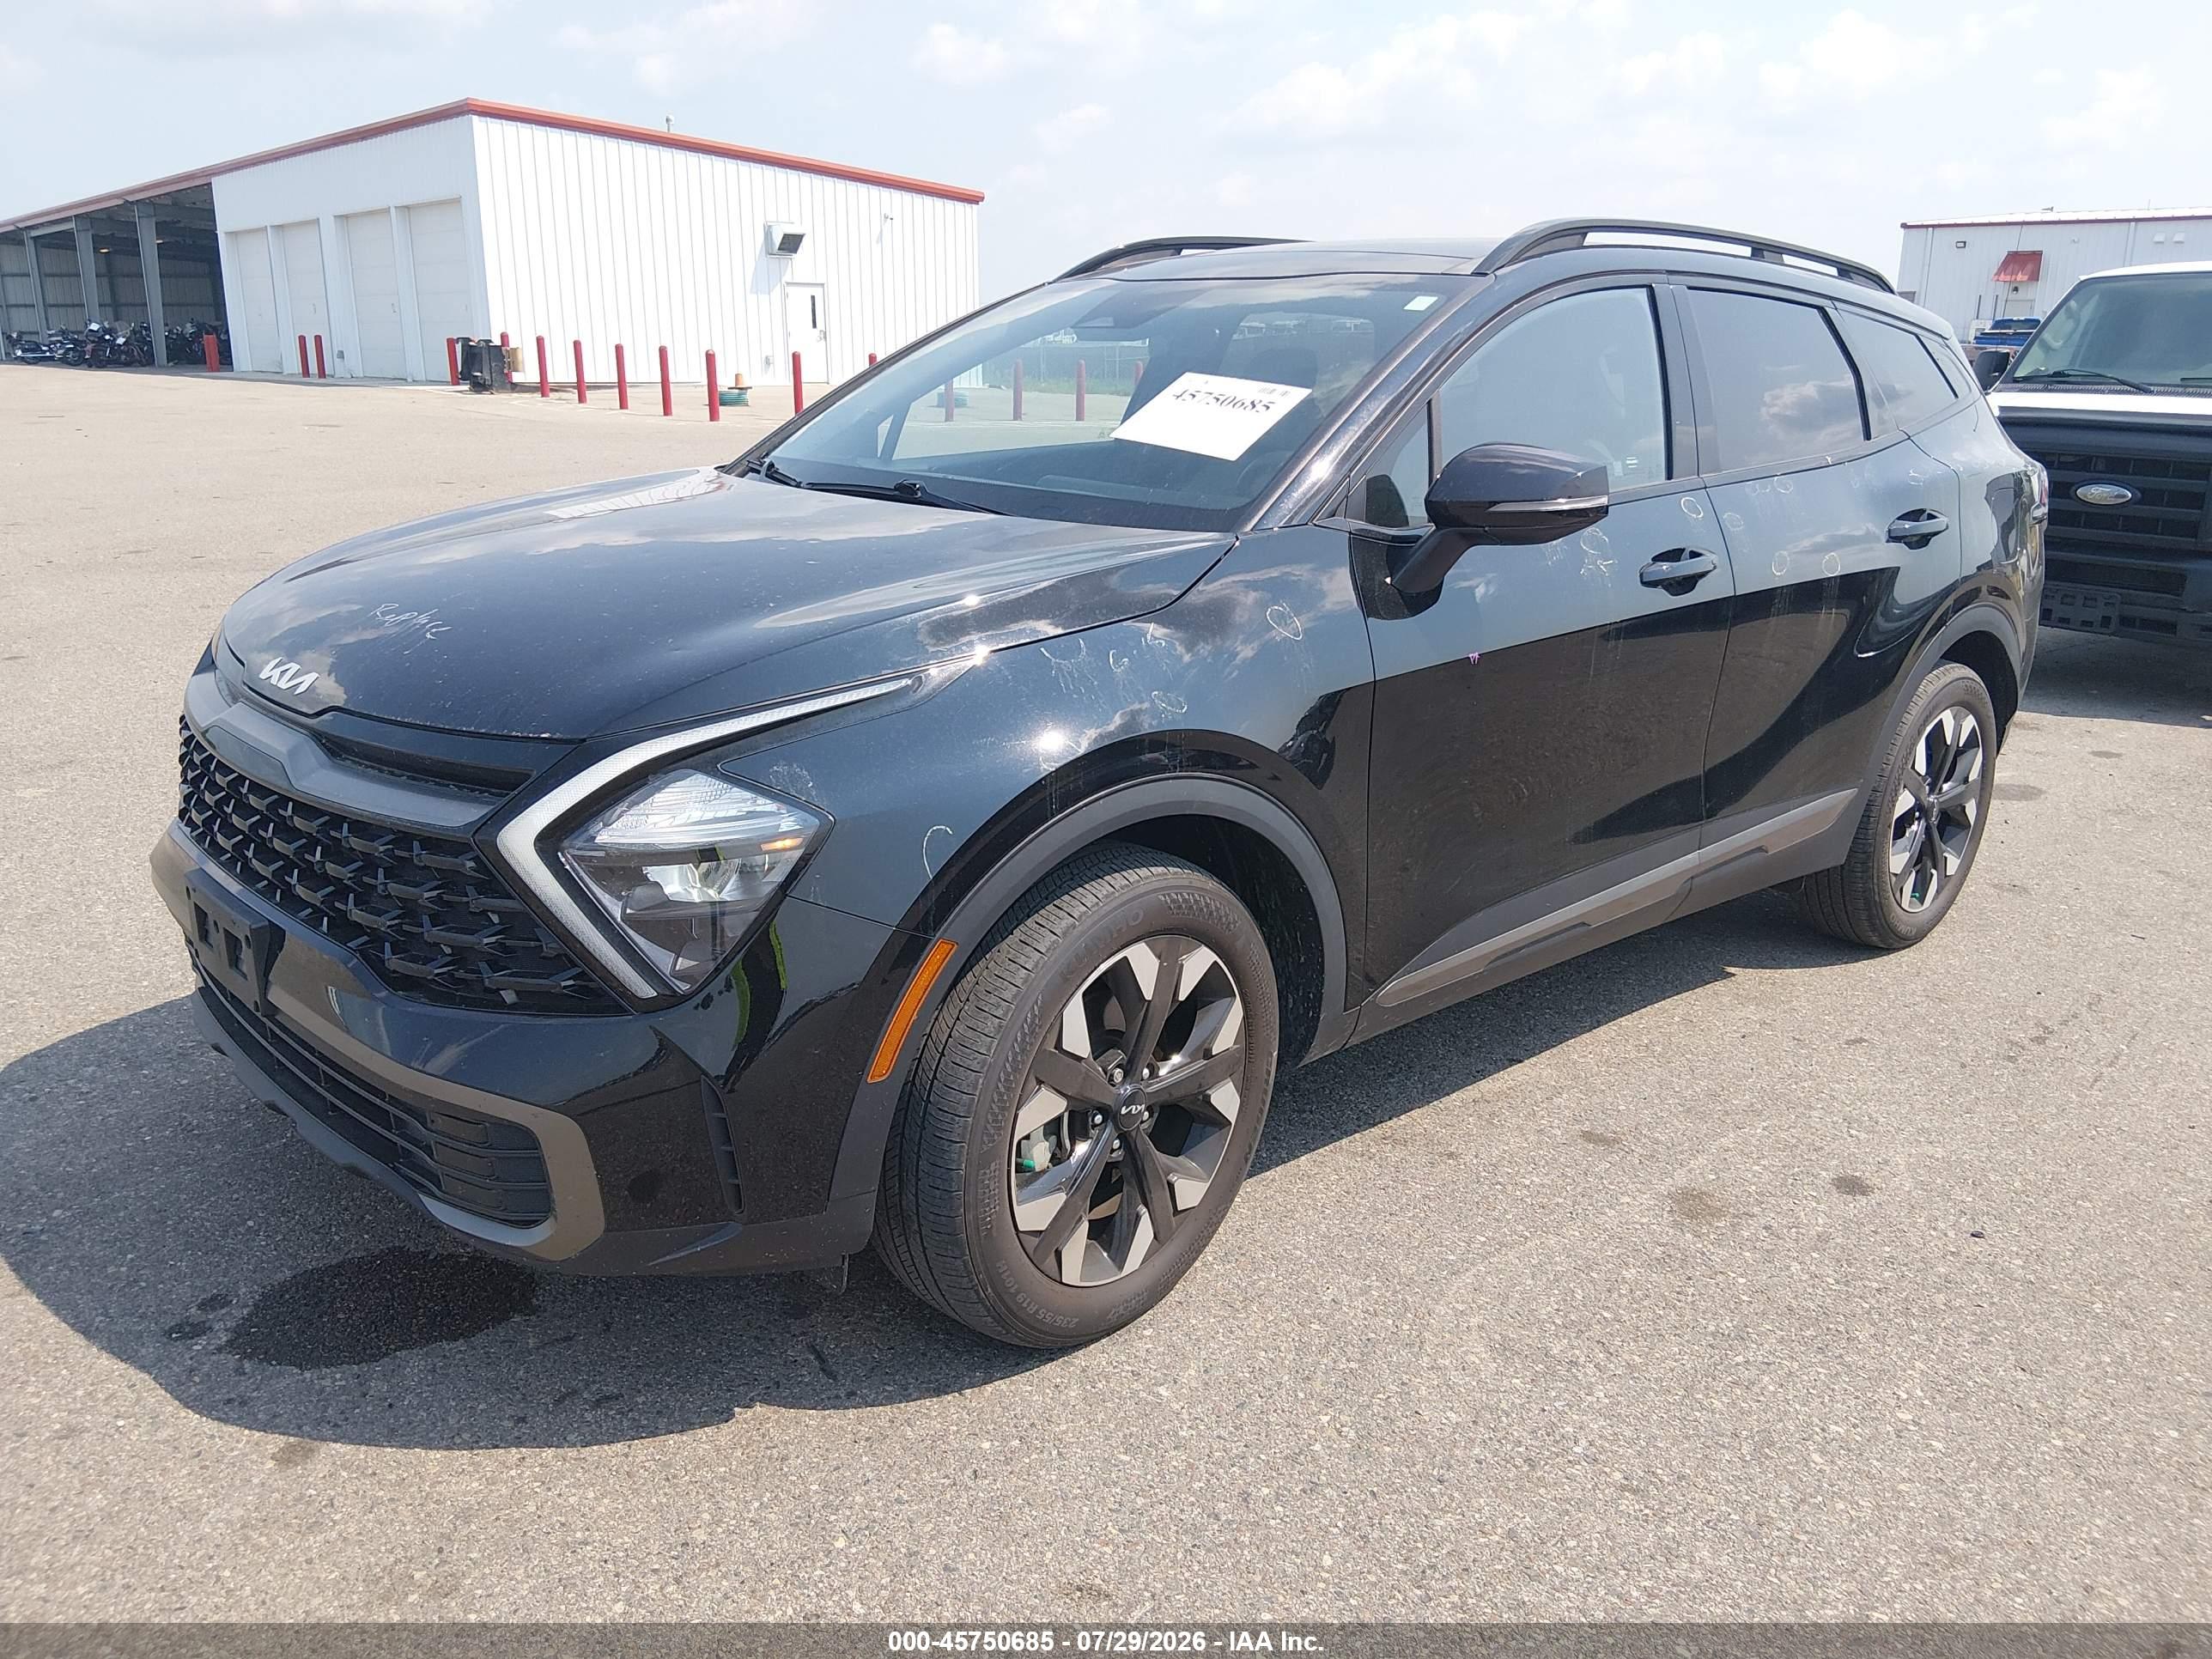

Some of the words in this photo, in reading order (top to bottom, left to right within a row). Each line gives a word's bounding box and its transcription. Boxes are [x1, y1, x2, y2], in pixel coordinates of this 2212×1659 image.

[1172, 389, 1276, 413] 45750685
[258, 656, 319, 696] KIA
[1016, 1291, 1038, 1315] R19
[1036, 1308, 1079, 1328] 235/55
